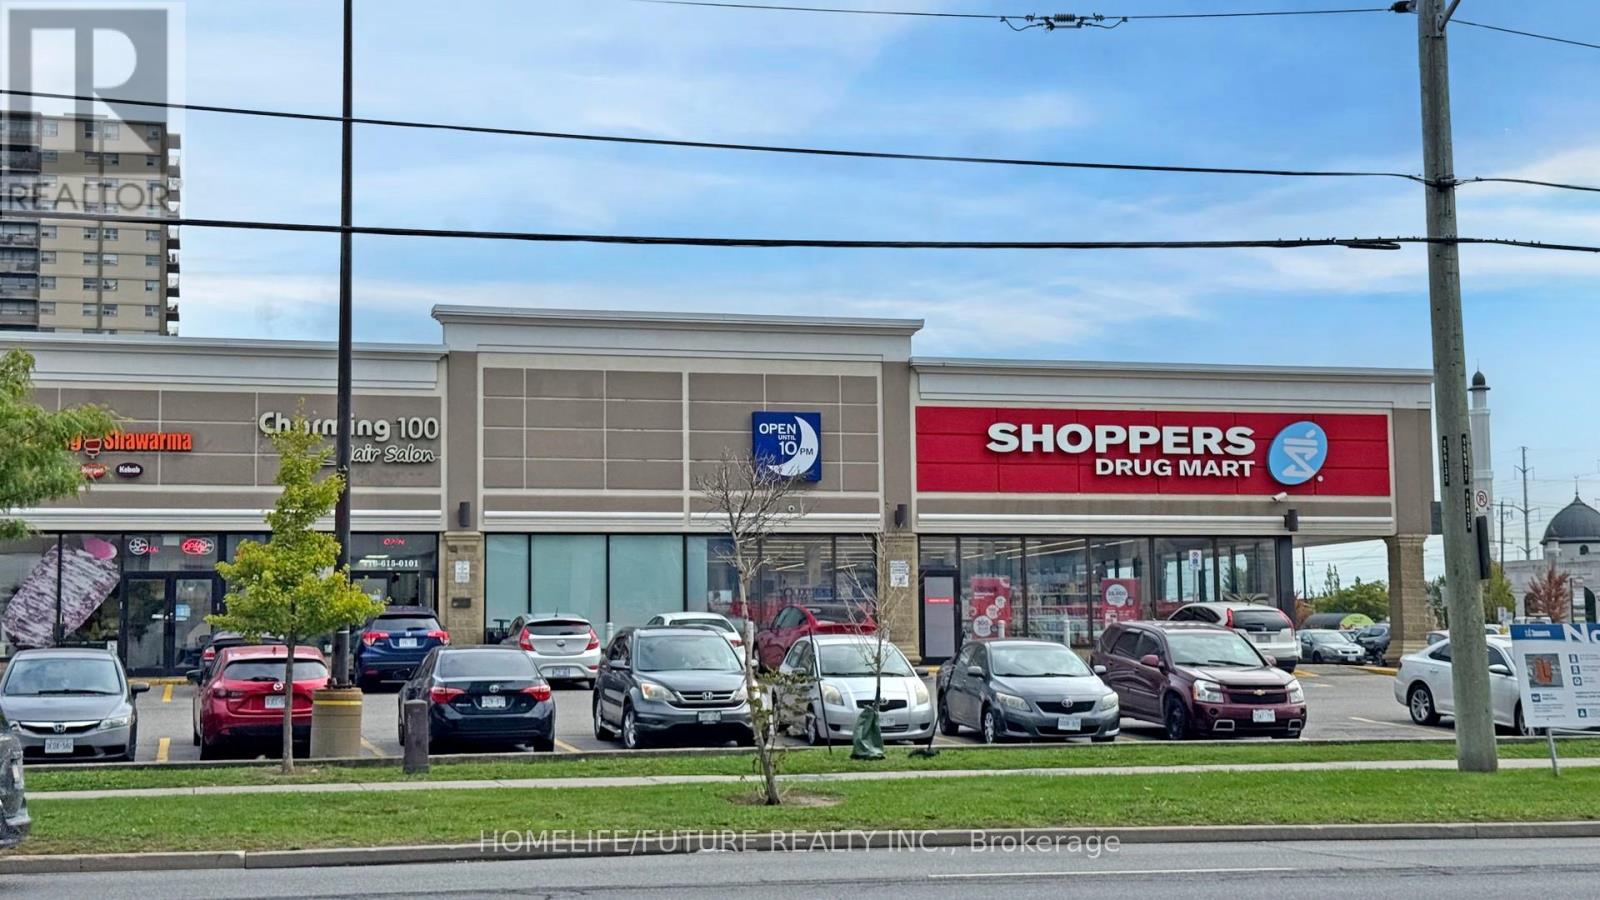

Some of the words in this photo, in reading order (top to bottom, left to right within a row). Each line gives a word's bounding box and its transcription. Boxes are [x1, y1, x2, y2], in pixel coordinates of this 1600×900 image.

[397, 417, 439, 439] 100
[759, 423, 796, 435] OPEN
[779, 441, 797, 455] 10
[986, 423, 1256, 455] SHOPPERS
[350, 444, 381, 462] air
[384, 443, 435, 463] Salon
[1095, 458, 1170, 476] DRUG
[1179, 460, 1255, 477] MART
